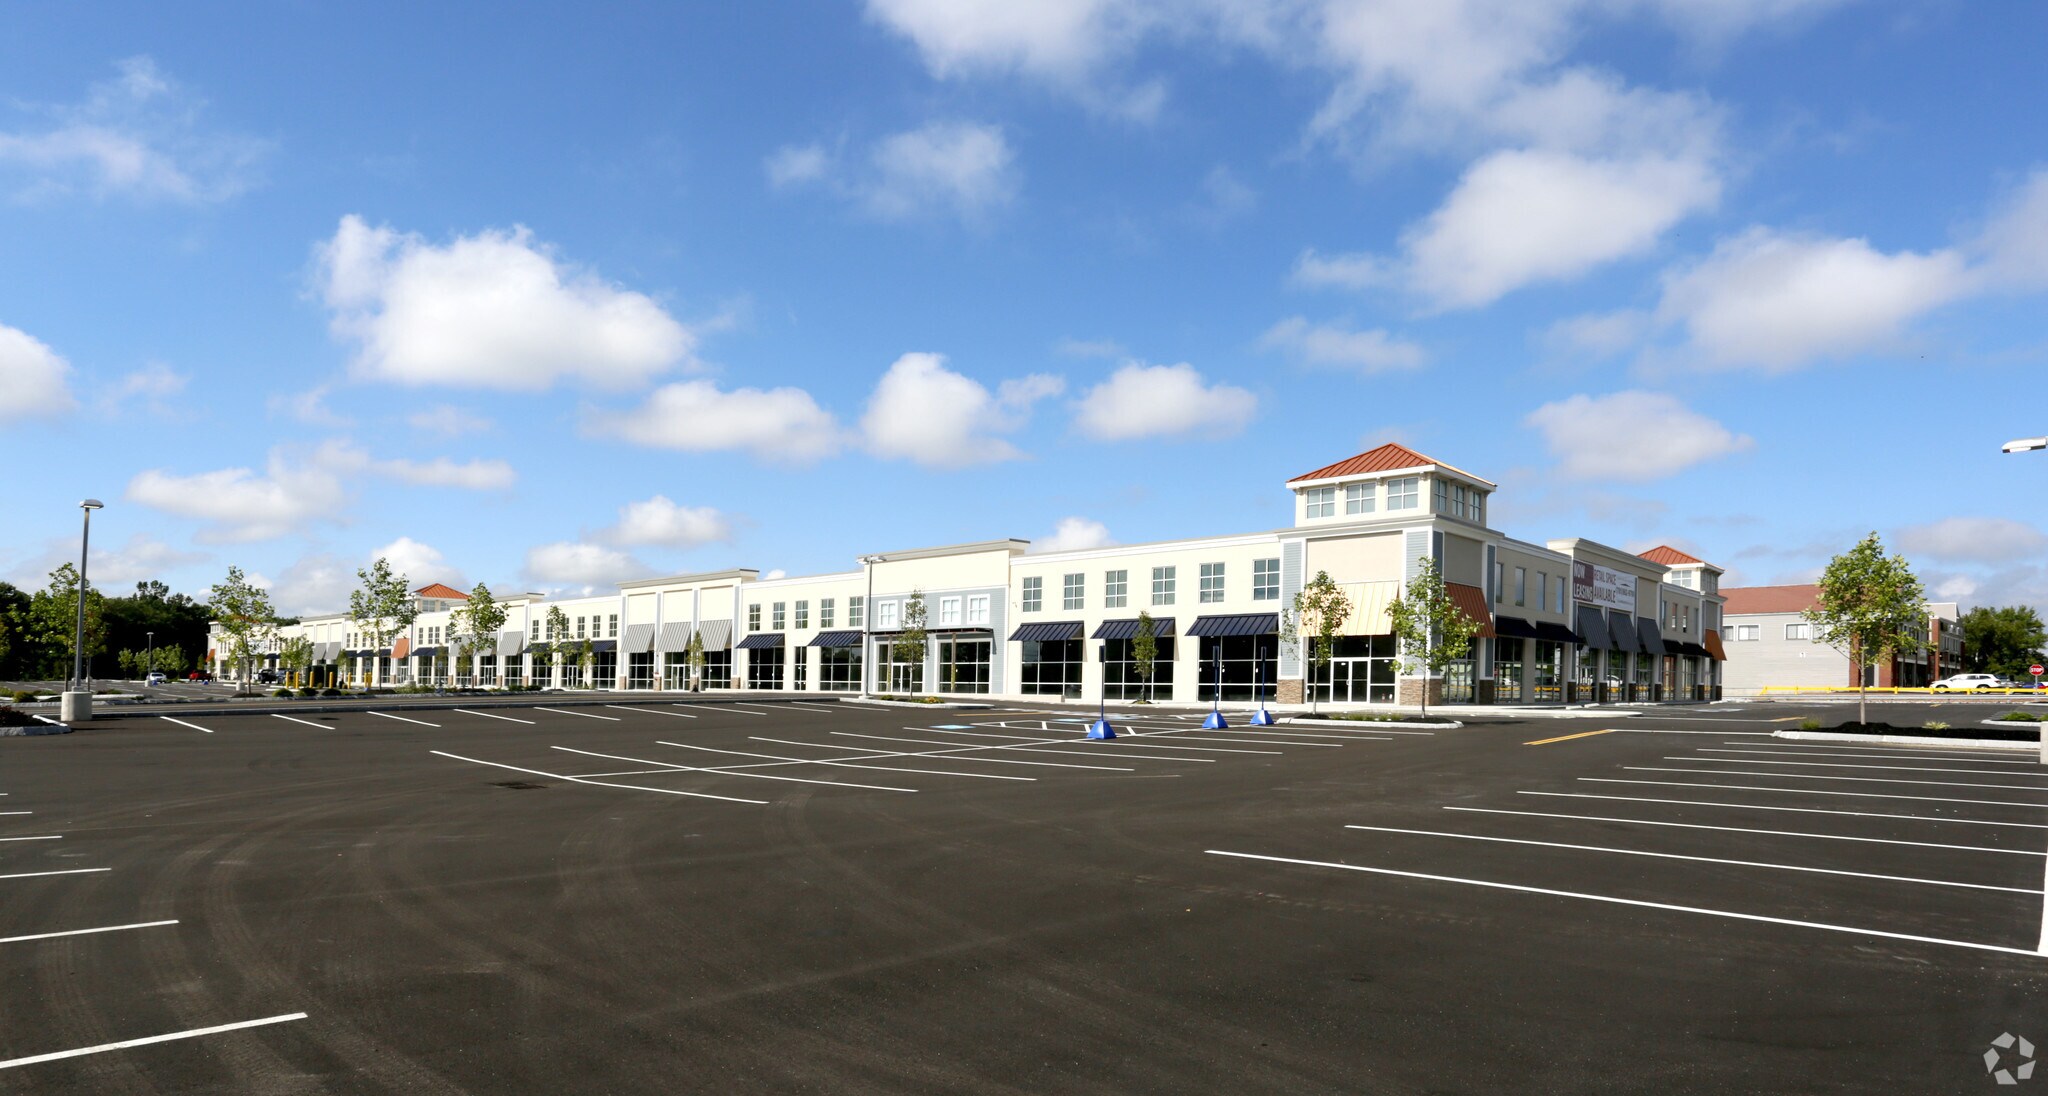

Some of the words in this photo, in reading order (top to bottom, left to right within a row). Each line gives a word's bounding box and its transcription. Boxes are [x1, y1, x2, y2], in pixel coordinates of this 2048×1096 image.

[1574, 563, 1585, 579] NOW
[1594, 569, 1605, 583] RETAIL
[1606, 572, 1616, 585] SPACE
[1573, 583, 1593, 601] LEASING
[1593, 585, 1616, 603] AVAILABLE
